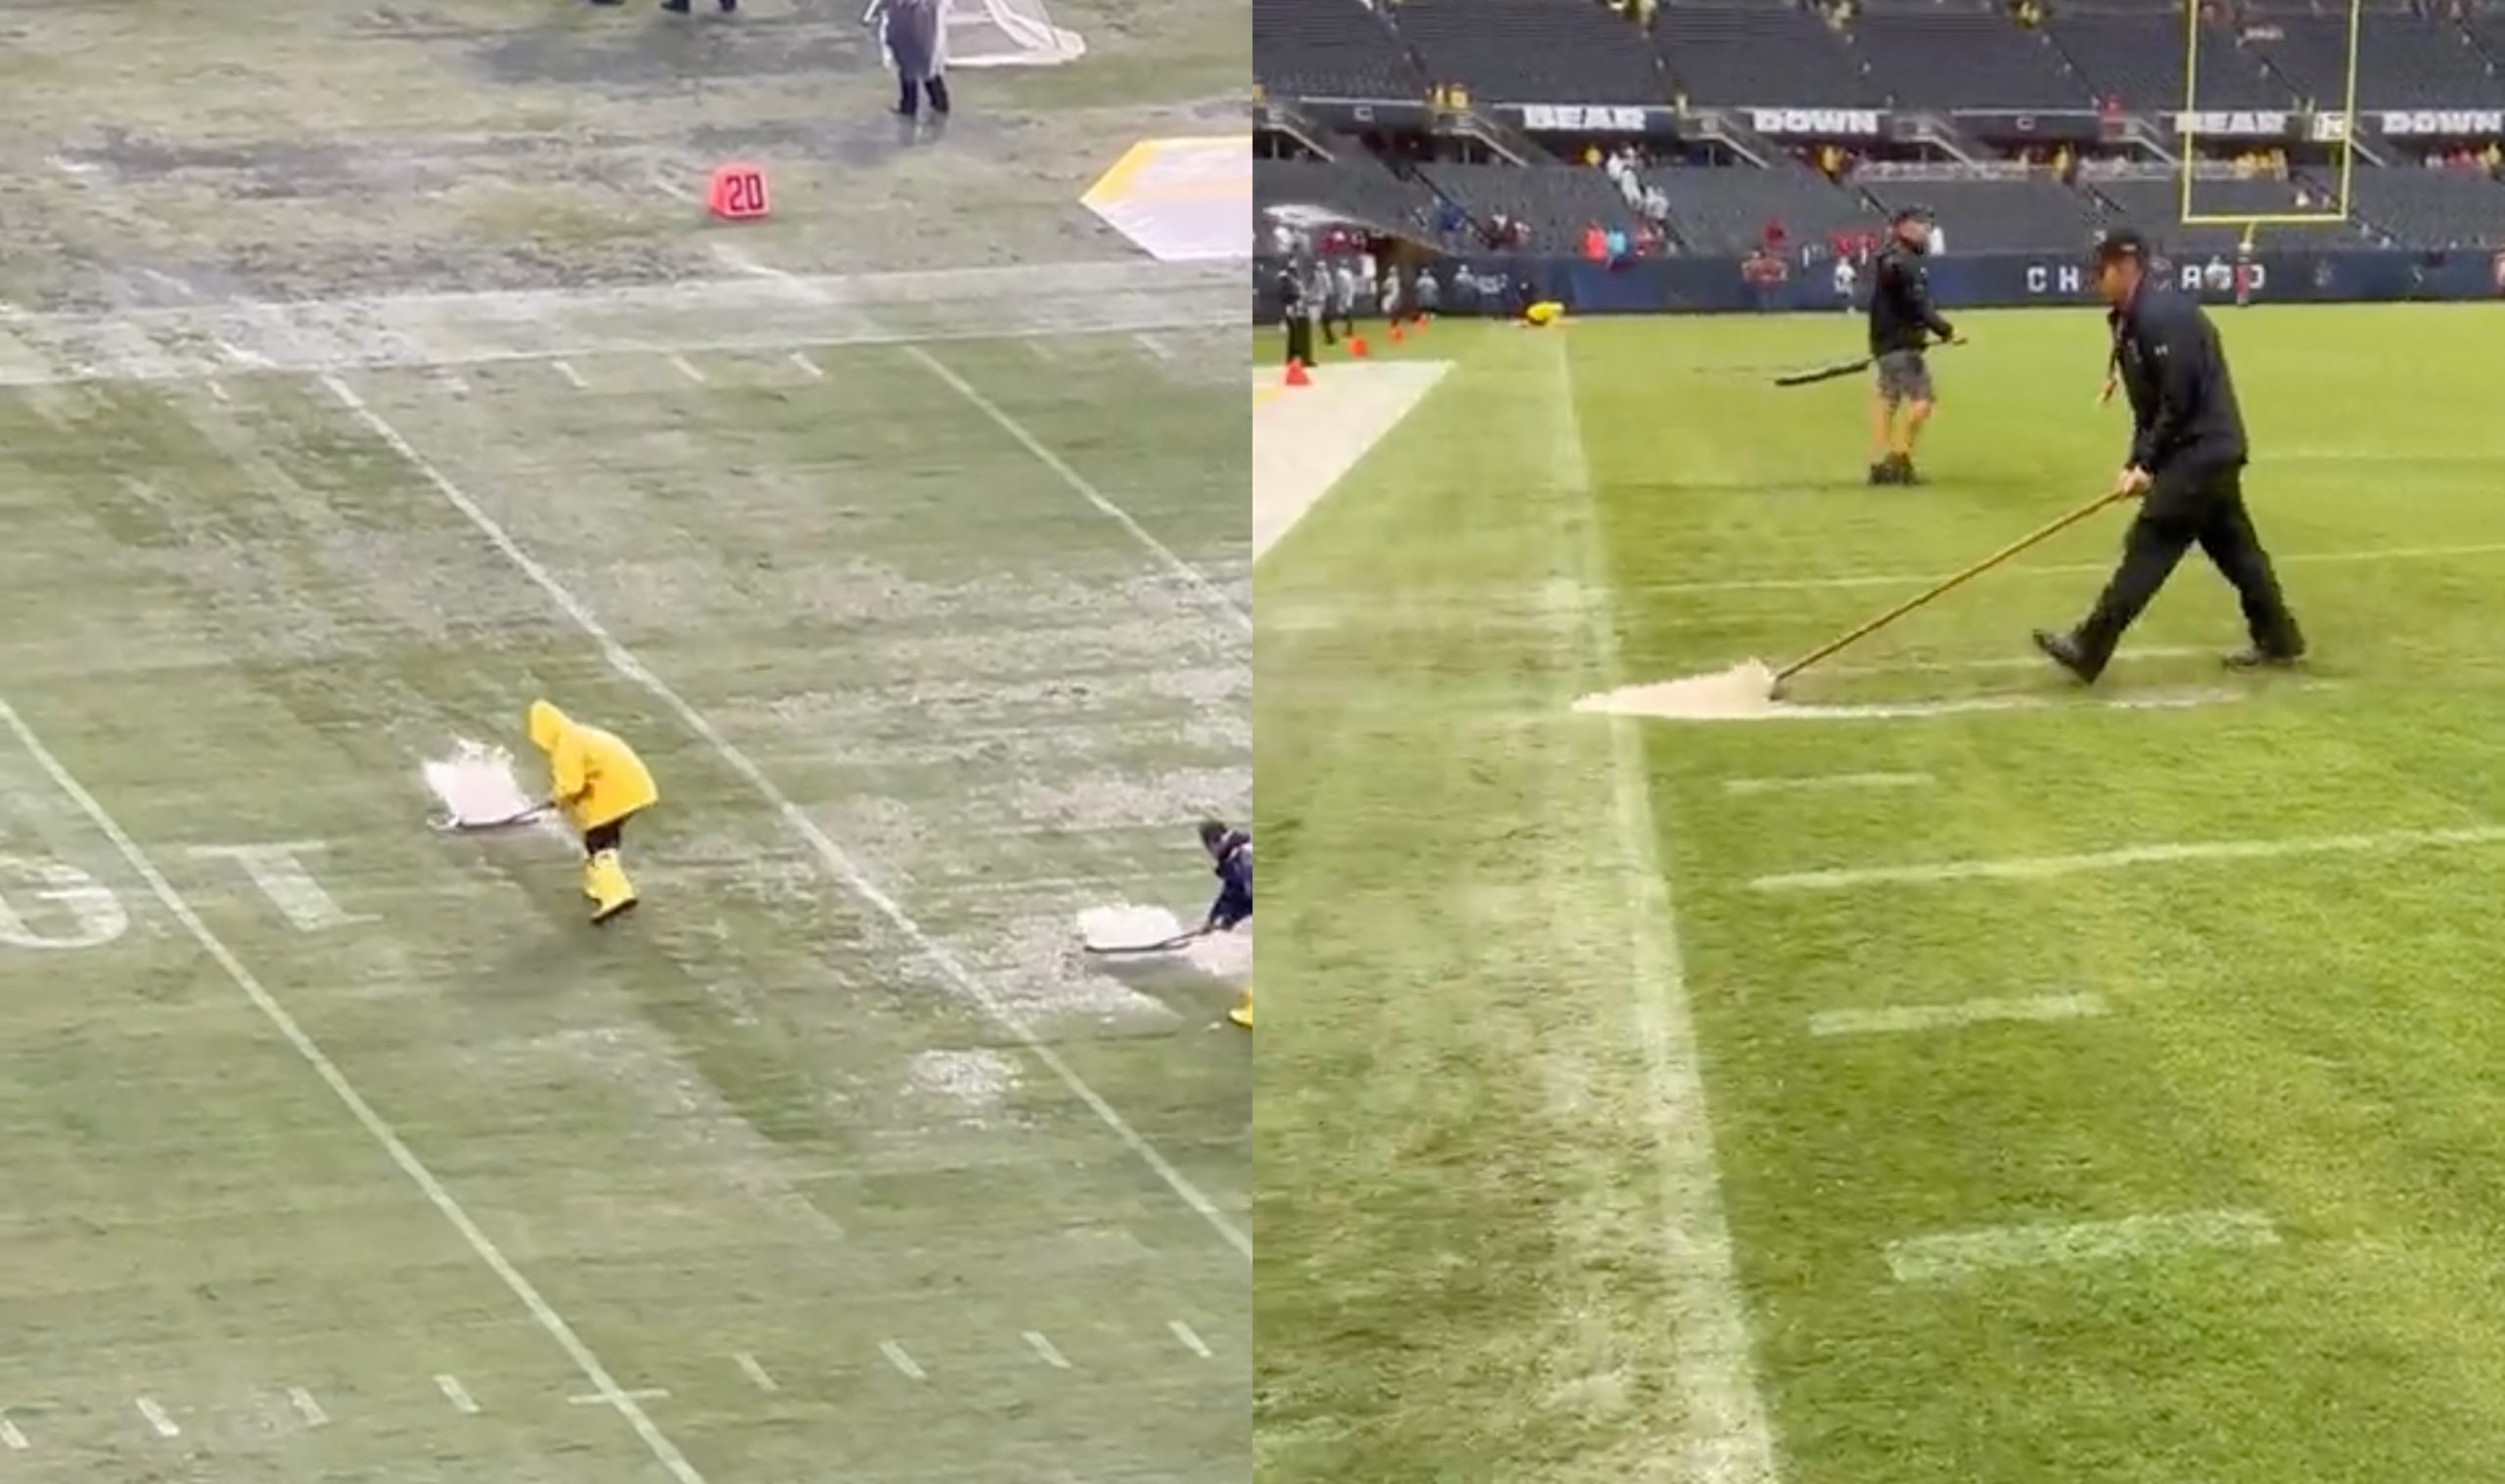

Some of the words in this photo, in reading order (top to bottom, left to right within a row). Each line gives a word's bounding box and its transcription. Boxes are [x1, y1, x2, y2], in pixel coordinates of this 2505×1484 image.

[1524, 105, 1645, 131] BEAR
[1754, 109, 1877, 134] DOWN
[2382, 111, 2502, 134] DOWN
[726, 174, 764, 211] 20
